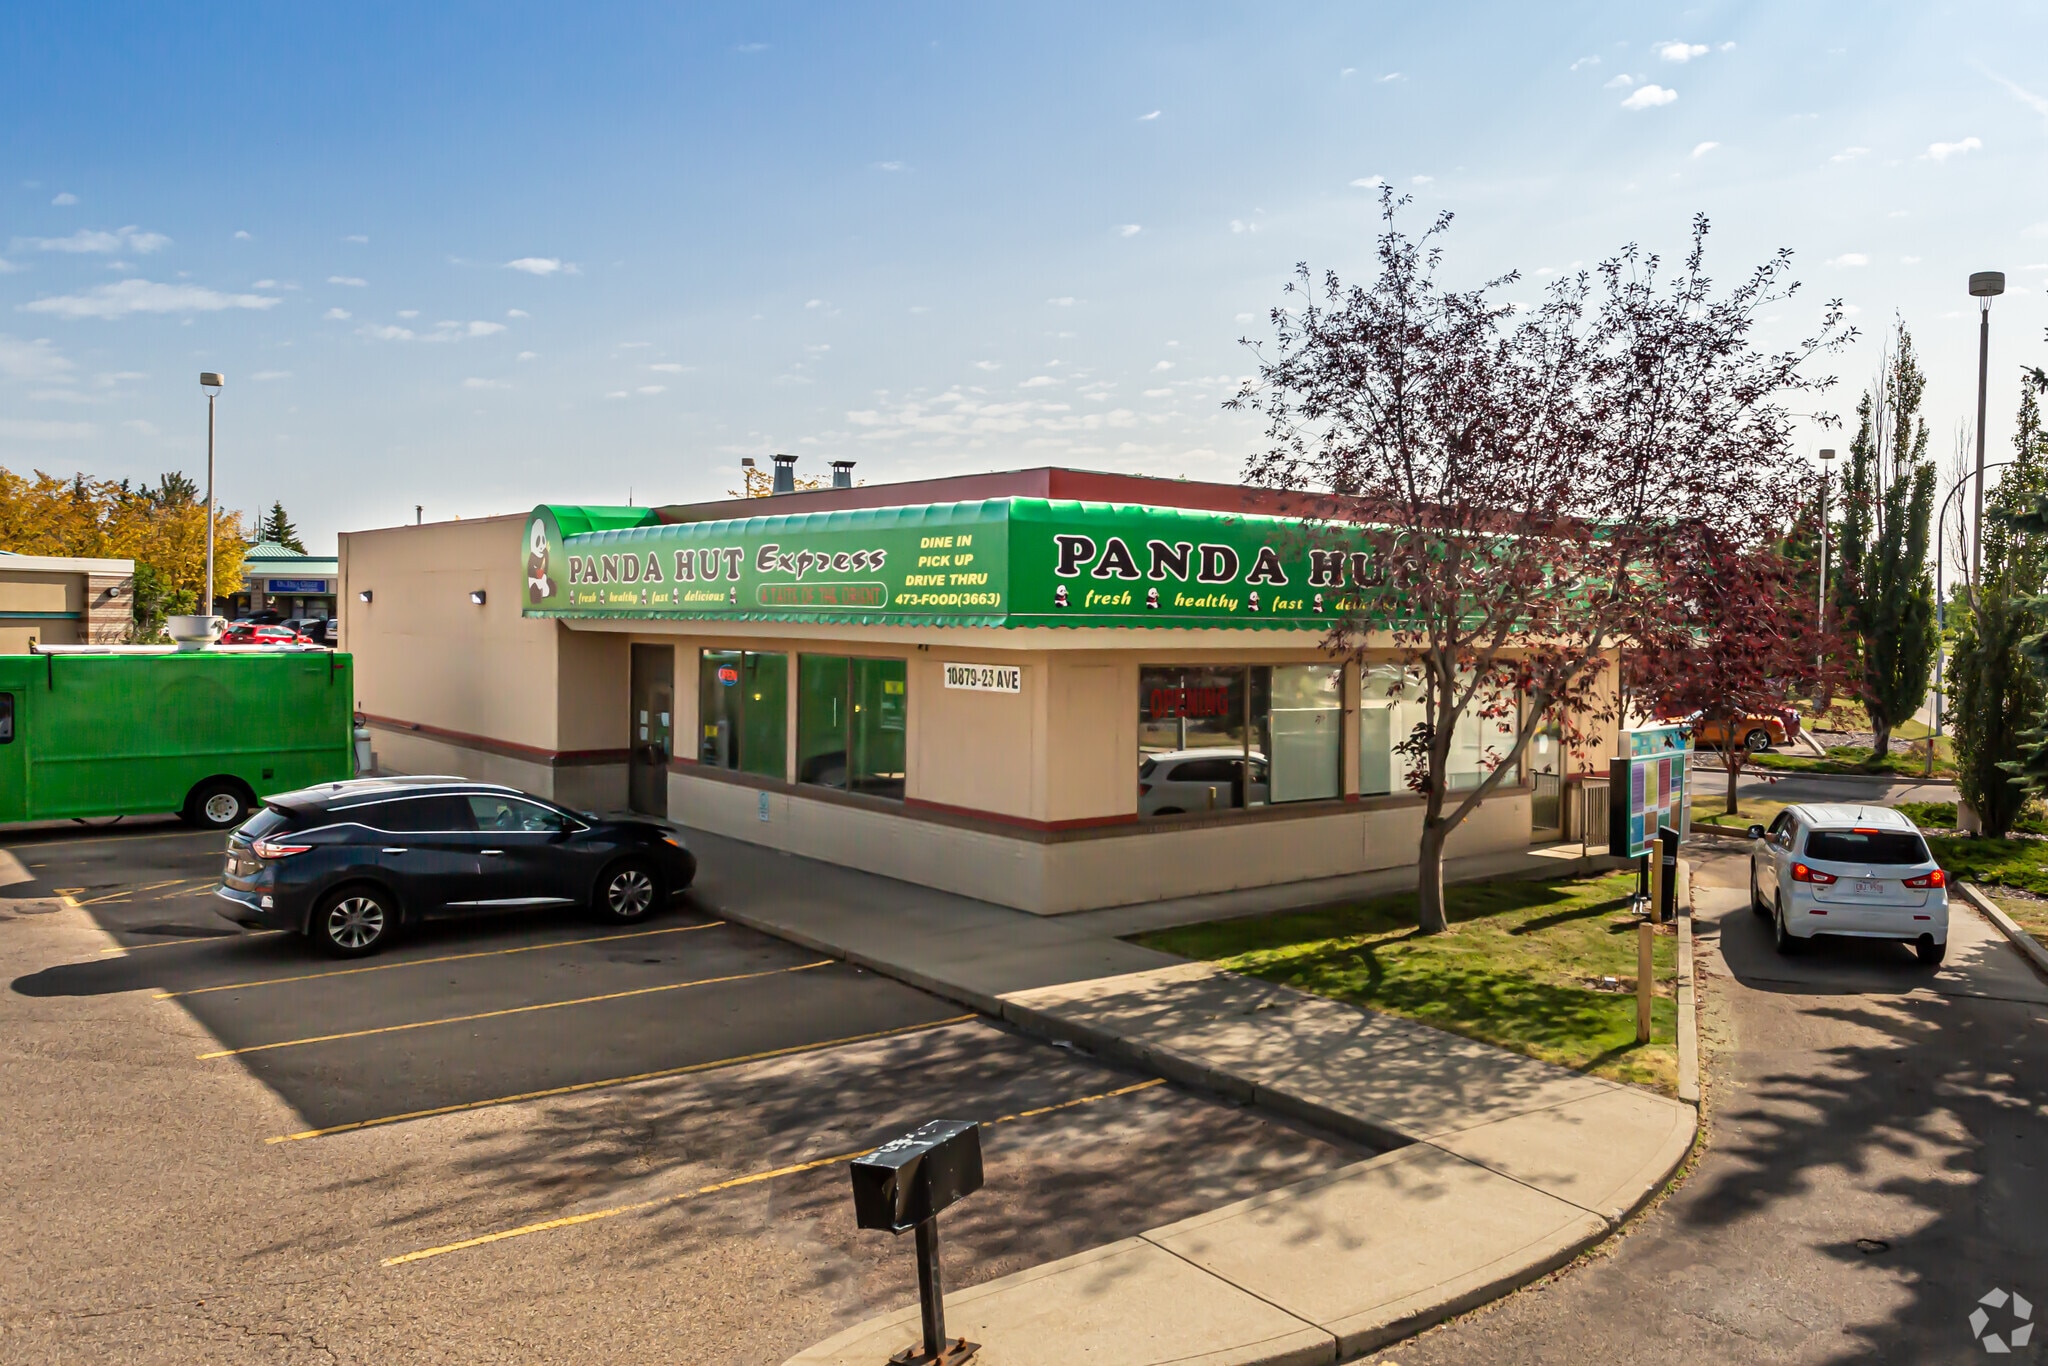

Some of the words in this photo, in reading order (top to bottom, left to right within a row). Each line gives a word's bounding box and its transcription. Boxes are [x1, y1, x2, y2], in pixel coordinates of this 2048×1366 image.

[920, 536, 953, 549] DINE
[956, 535, 972, 547] IN
[568, 551, 664, 584] PANDA
[673, 547, 744, 582] HUT
[756, 544, 888, 580] Express
[918, 555, 950, 567] PICK
[954, 554, 974, 566] UP
[1053, 533, 1289, 586] PANDA
[905, 574, 945, 586] DRIVE
[950, 573, 988, 585] THRU
[578, 591, 597, 603] fresh
[609, 591, 638, 604] healthy
[652, 591, 668, 604] fast
[684, 591, 725, 602] delicious
[895, 593, 1001, 607] 473-FOOD(3663)
[1085, 589, 1132, 607] fresh
[1174, 592, 1239, 612] healthy
[1272, 596, 1303, 611] fast
[947, 667, 994, 687] 10879-23
[996, 670, 1019, 689] AVE
